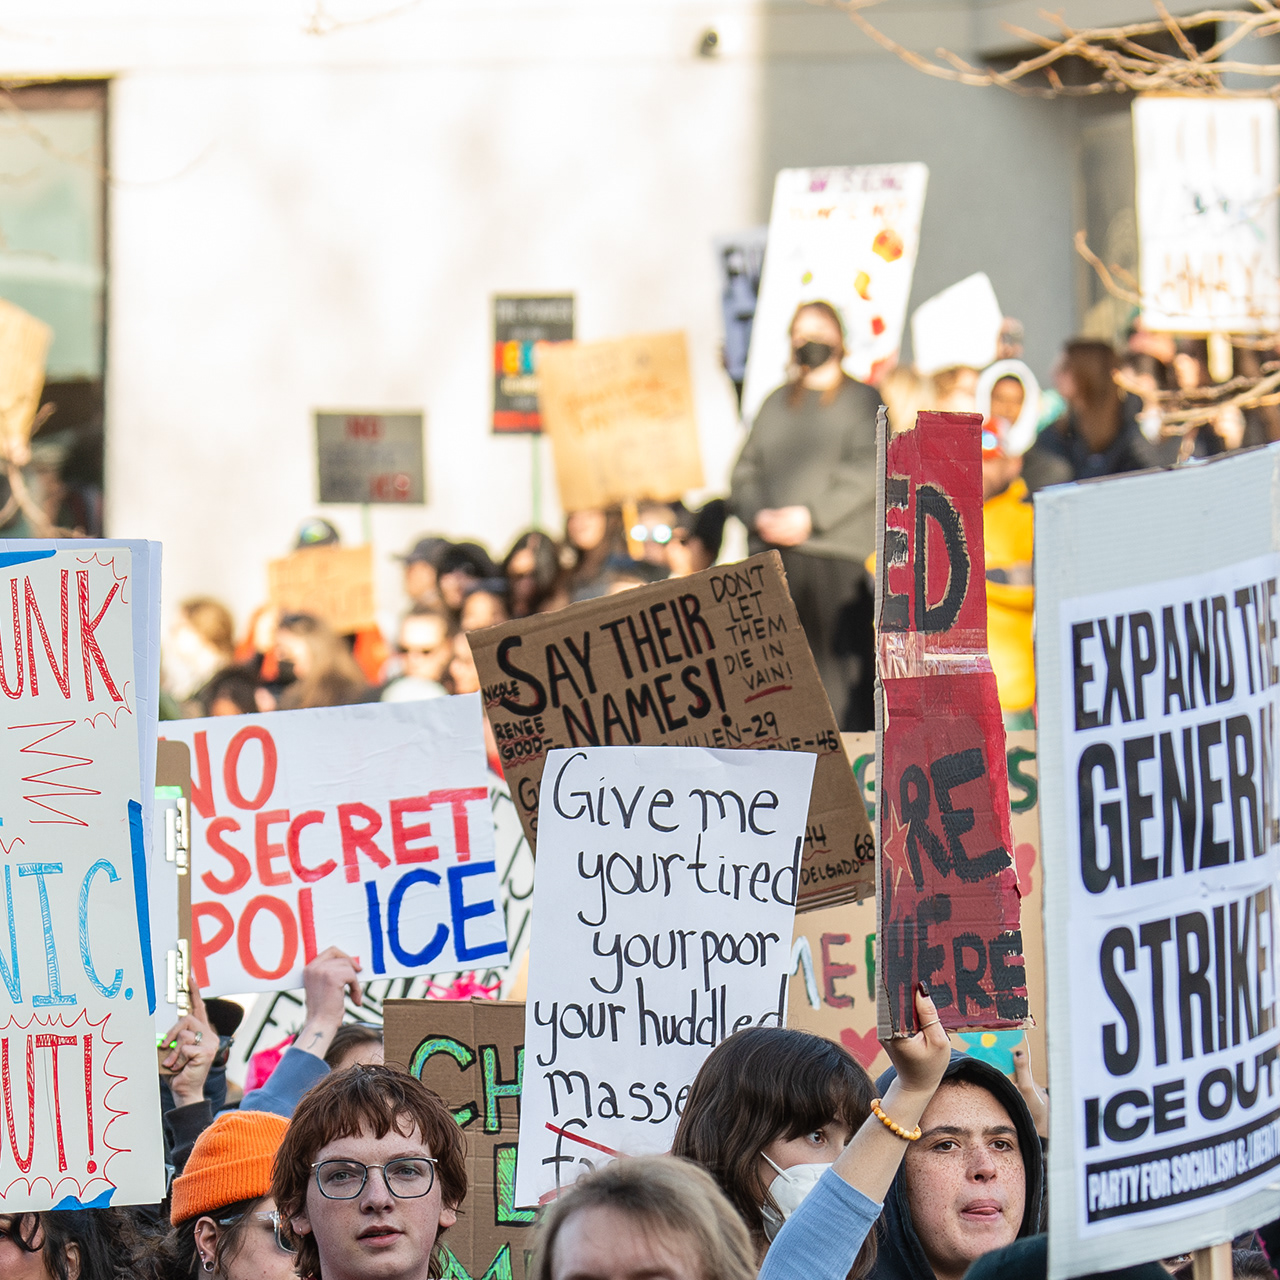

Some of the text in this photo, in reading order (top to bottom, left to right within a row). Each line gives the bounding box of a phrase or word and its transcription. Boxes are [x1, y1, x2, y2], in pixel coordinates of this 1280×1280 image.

[881, 473, 972, 635] ED
[725, 613, 787, 646] THEM
[727, 590, 764, 623] LET
[496, 592, 716, 717] SAY THEIR
[723, 640, 784, 675] DIE IN
[742, 661, 793, 690] VAIN!
[1071, 593, 1237, 732] EXPAND
[494, 716, 546, 742] RENEE
[561, 656, 733, 747] NAMES!
[160, 725, 277, 820] NO
[553, 752, 679, 833] Give
[688, 788, 781, 836] me
[202, 786, 489, 896] SECRET
[365, 860, 508, 974] ICE
[535, 996, 626, 1068] your
[544, 1067, 693, 1126] masse
[1084, 1078, 1186, 1149] ICE
[1088, 1163, 1141, 1213] PARTY
[1140, 1158, 1171, 1202] FOR
[1171, 1140, 1236, 1195] SOCIALISM
[1236, 1137, 1248, 1175] &
